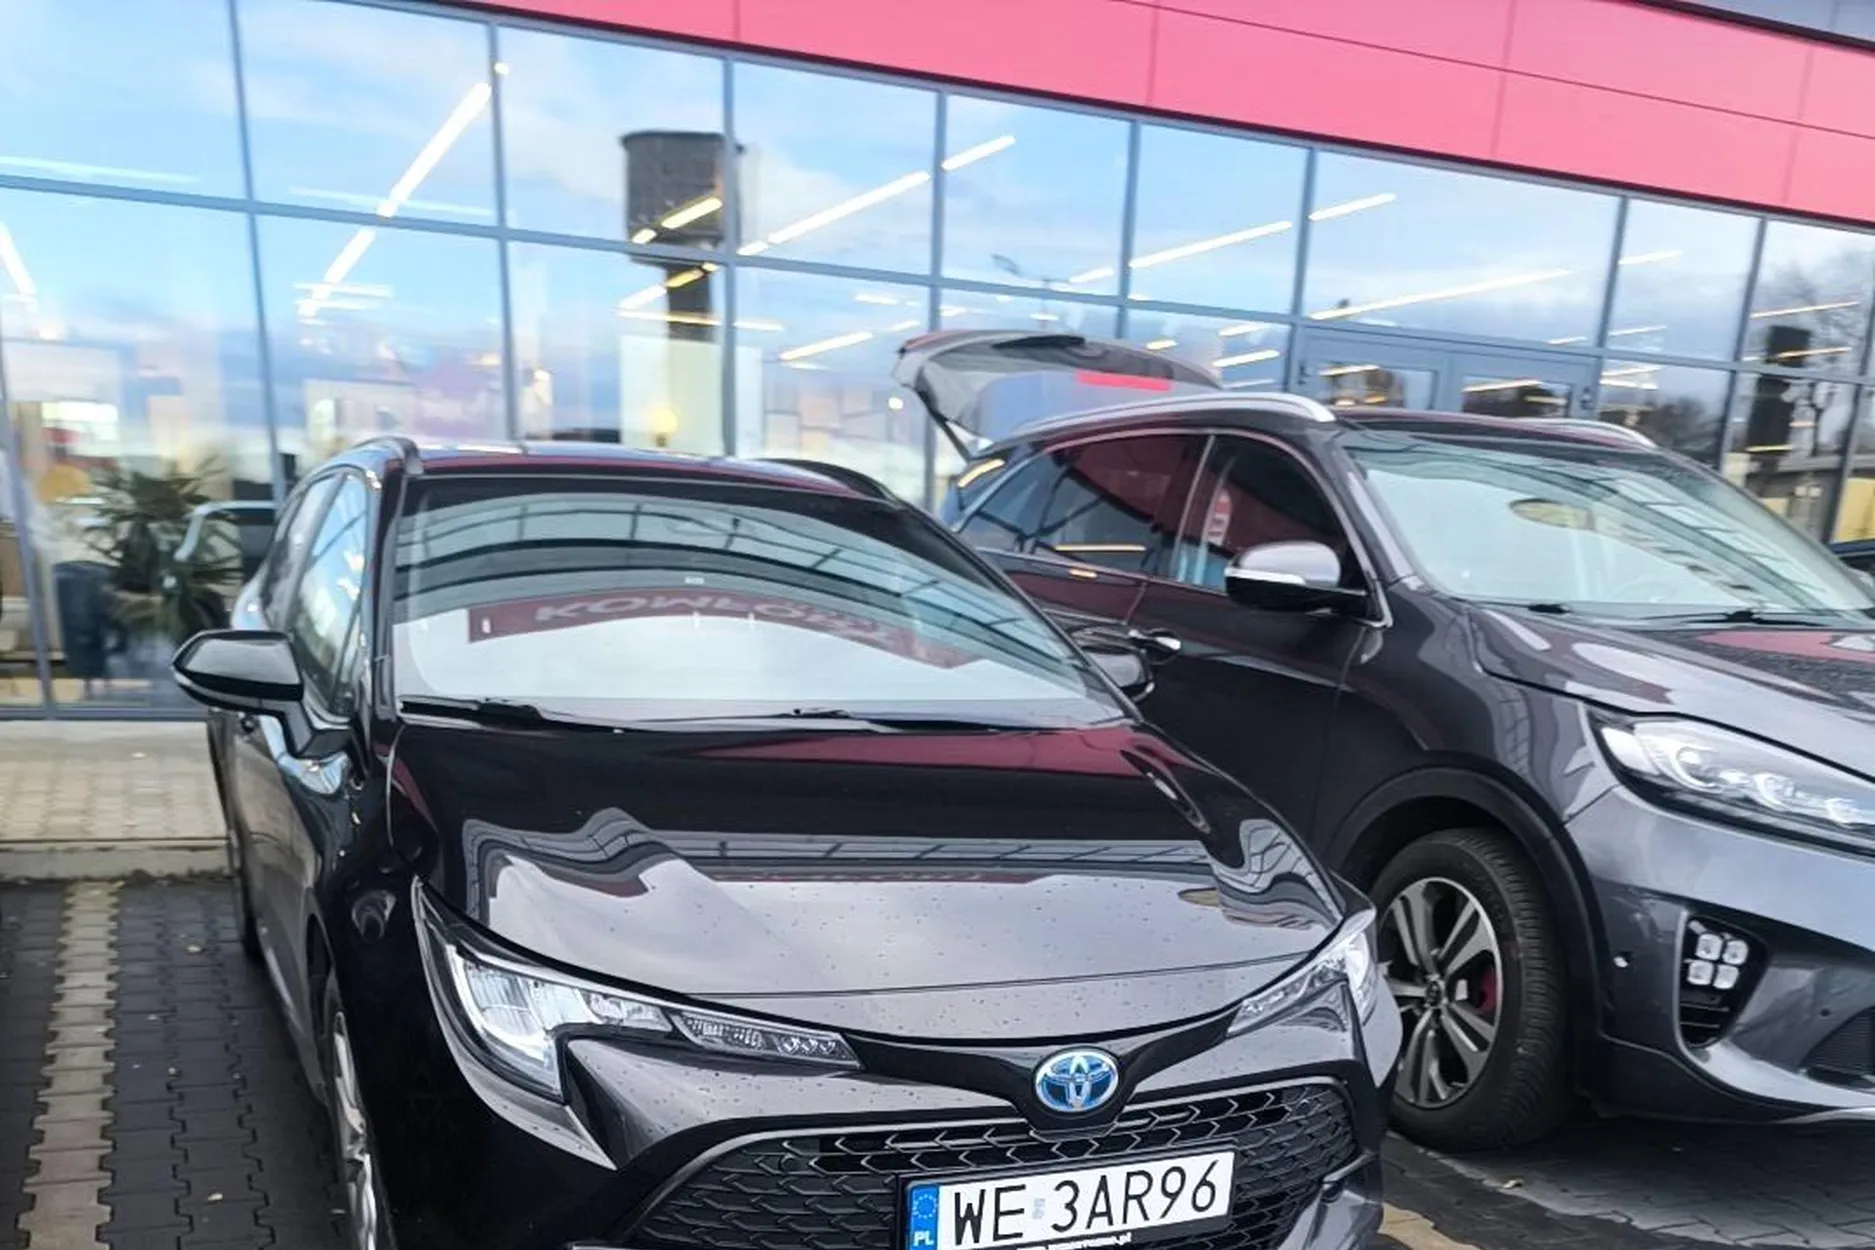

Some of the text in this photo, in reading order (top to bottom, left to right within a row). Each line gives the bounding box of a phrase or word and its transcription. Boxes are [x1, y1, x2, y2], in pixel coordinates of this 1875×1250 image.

[954, 1160, 1219, 1246] WE 3AR96
[912, 1230, 936, 1247] PL
